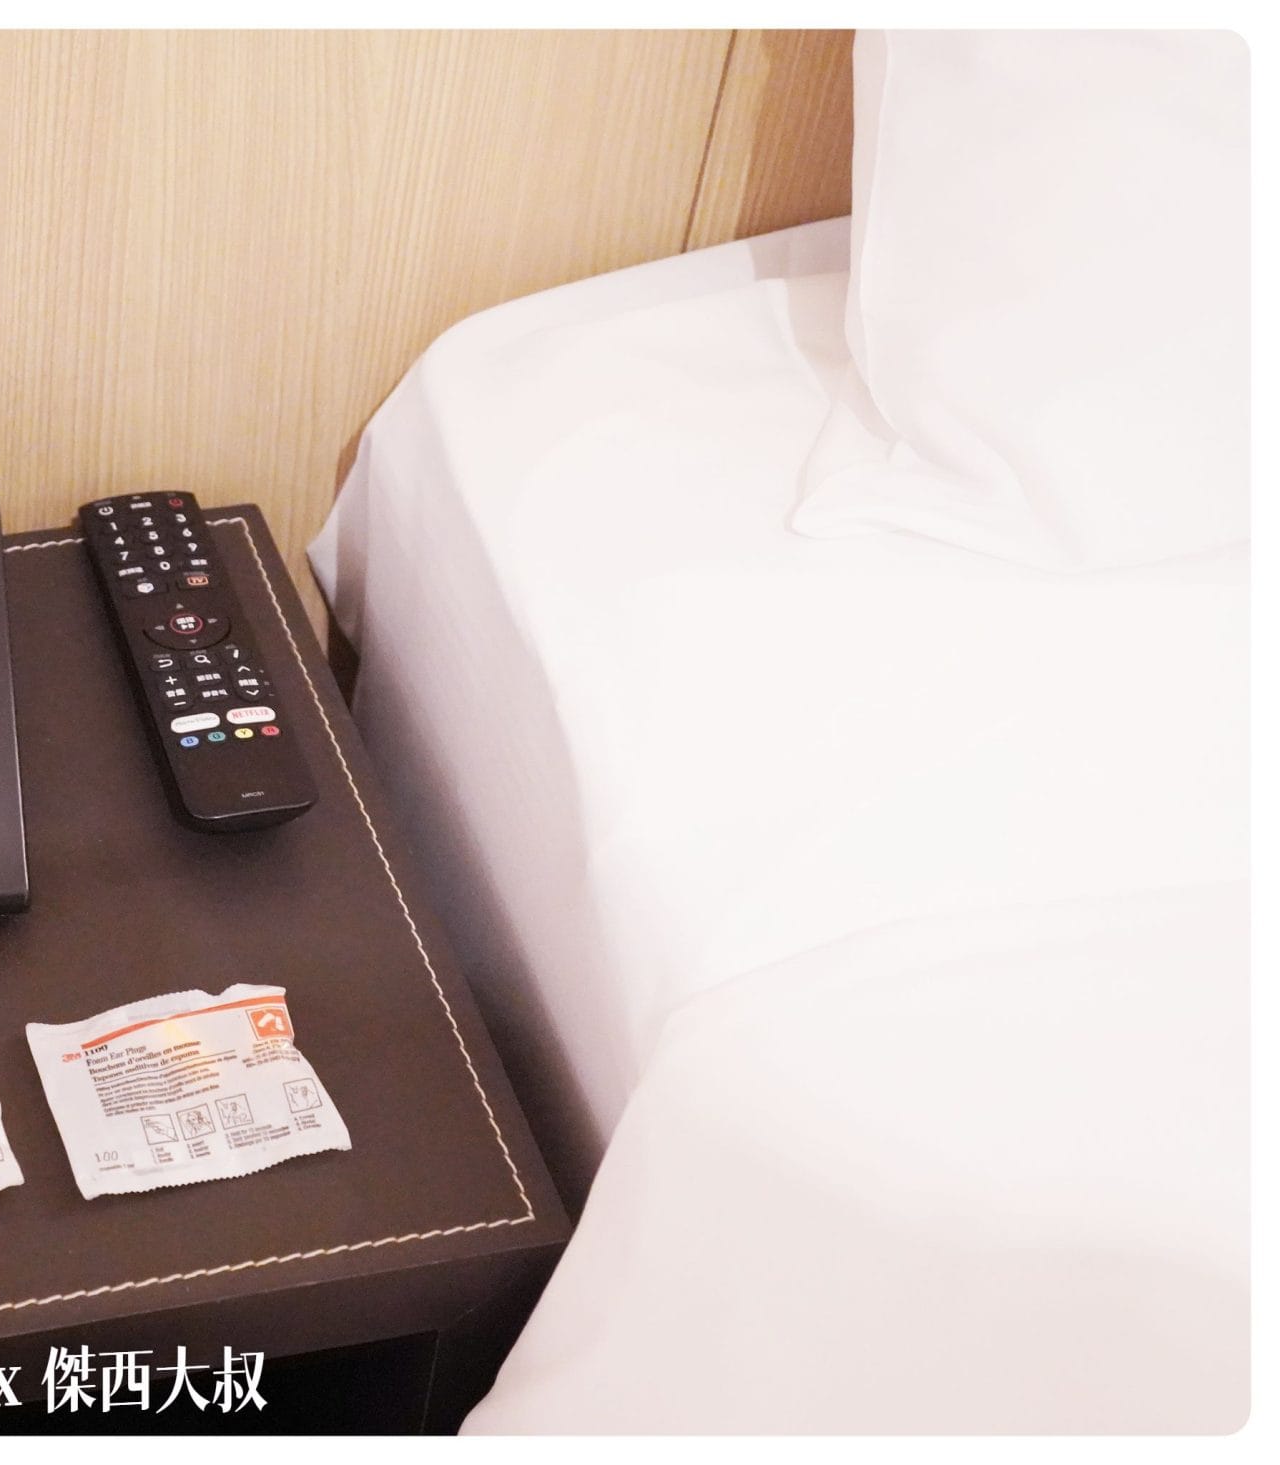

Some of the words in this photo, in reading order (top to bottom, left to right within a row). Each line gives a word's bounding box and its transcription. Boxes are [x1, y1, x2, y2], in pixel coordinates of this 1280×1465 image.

[142, 516, 154, 526] 2
[175, 513, 187, 523] 3
[110, 522, 118, 531] 1
[148, 531, 159, 540] 5
[182, 528, 192, 537] 6
[114, 536, 125, 545] 4
[153, 546, 165, 555] 8
[187, 542, 198, 552] 9
[120, 551, 129, 560] 7
[160, 561, 171, 571] 0
[86, 1056, 109, 1067] Foam
[110, 1051, 125, 1060] Ear
[125, 1045, 147, 1056] Plugs
